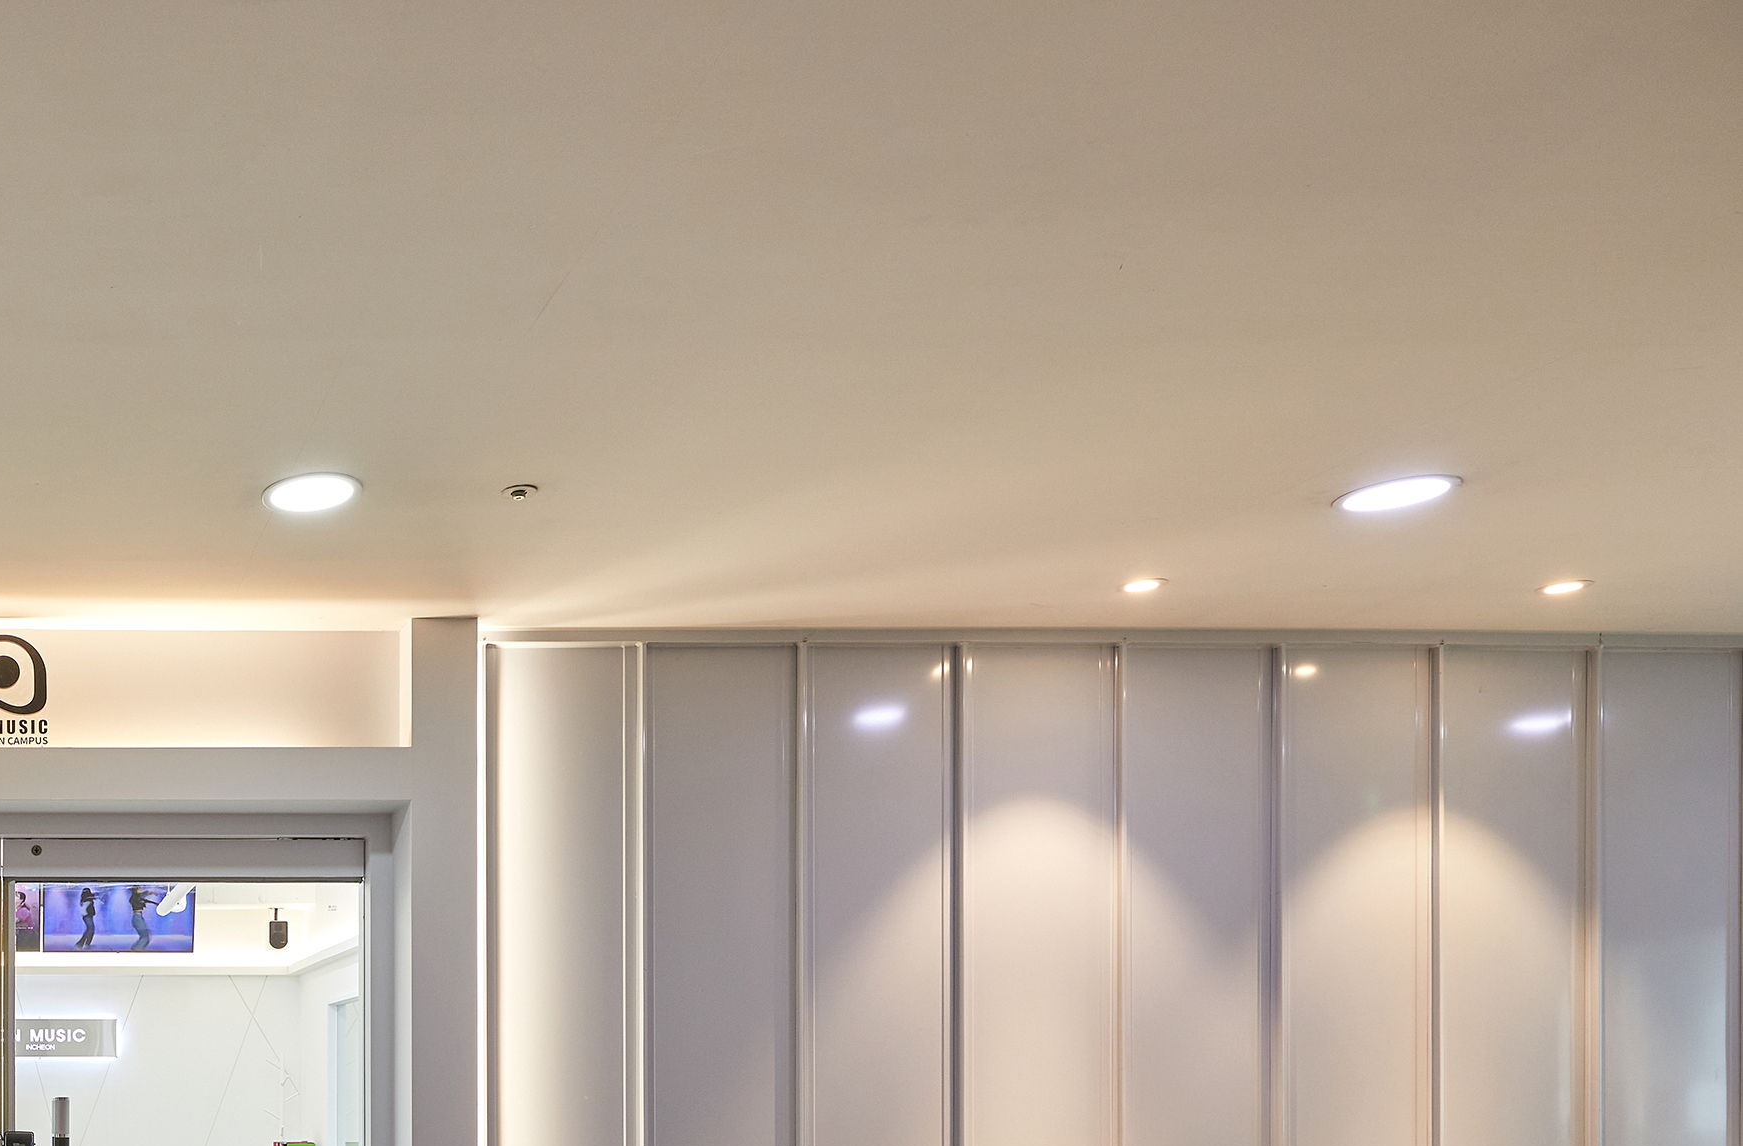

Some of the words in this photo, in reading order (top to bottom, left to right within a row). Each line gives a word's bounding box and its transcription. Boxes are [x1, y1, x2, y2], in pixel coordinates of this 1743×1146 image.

[7, 736, 49, 746] CAMPUS
[29, 1028, 86, 1043] MUSIC
[25, 1043, 56, 1051] INCHEON
